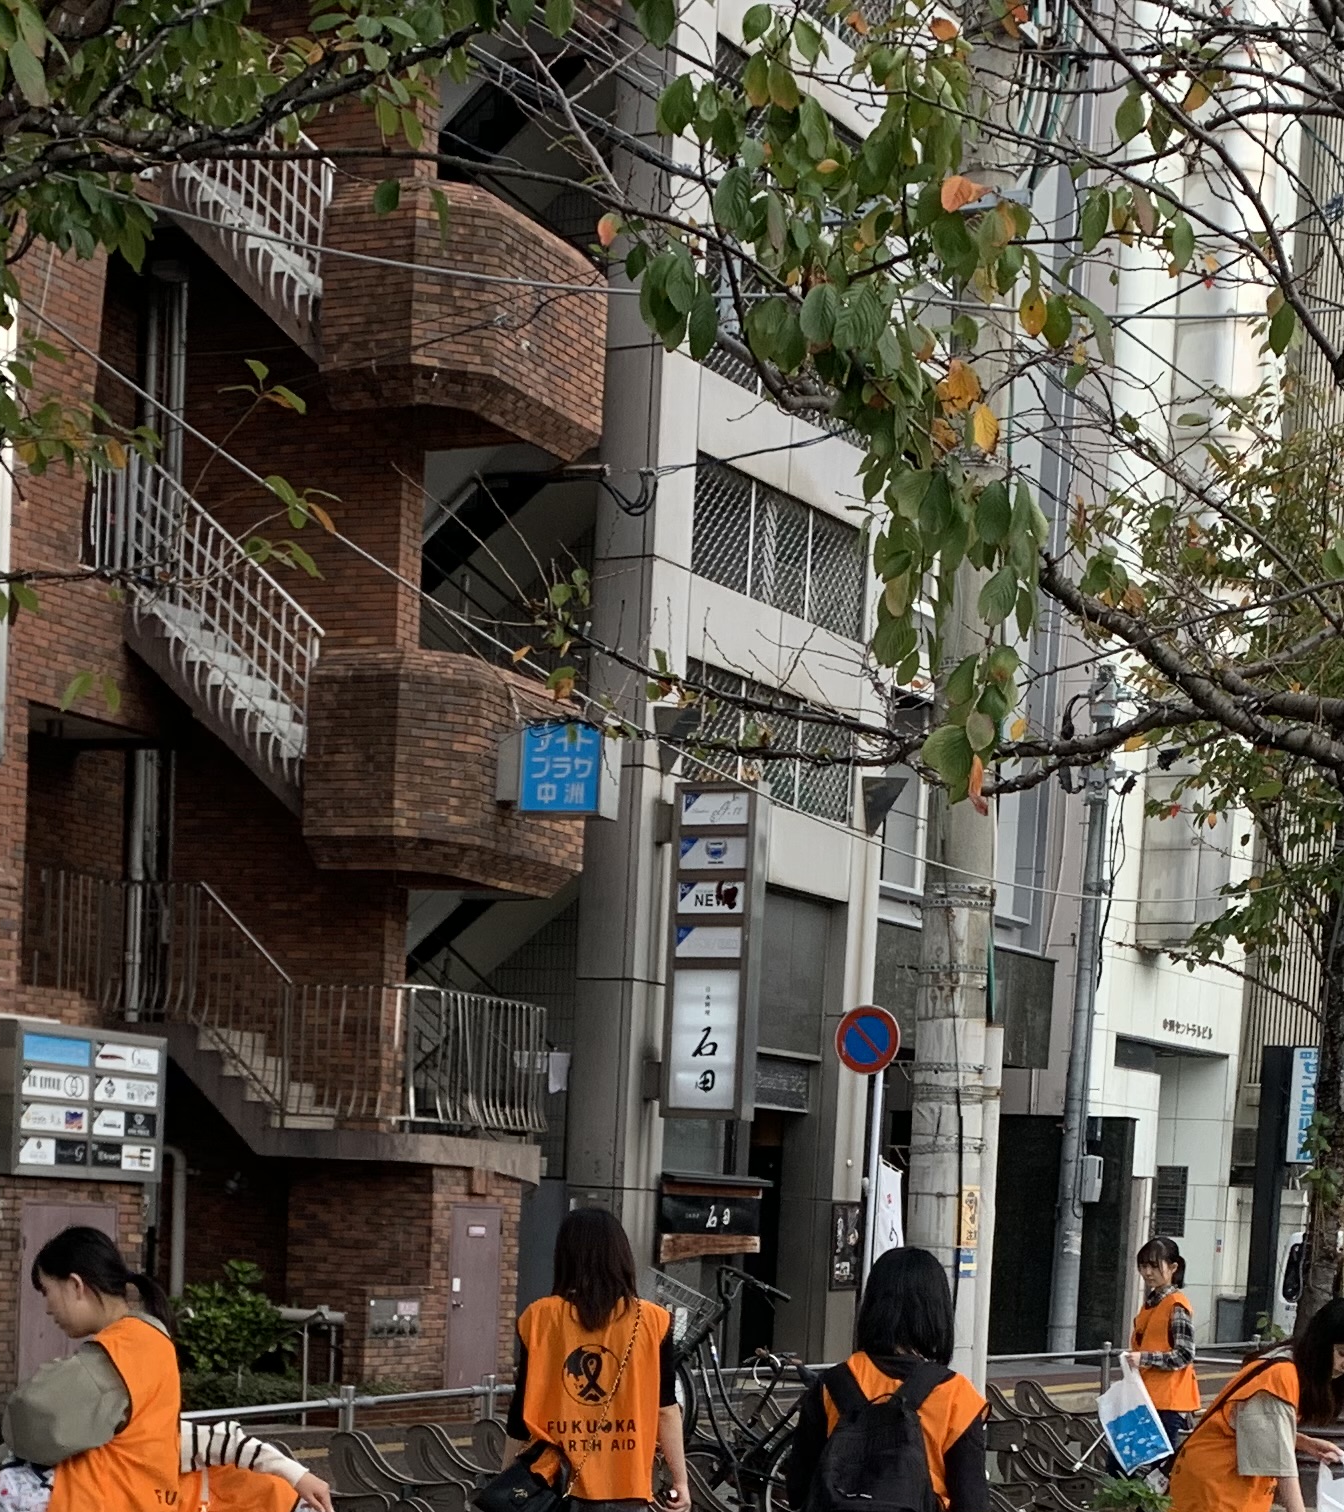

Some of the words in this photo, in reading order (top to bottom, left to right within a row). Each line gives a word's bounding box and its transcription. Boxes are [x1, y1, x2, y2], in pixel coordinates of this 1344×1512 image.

[537, 782, 584, 804] 中洲
[691, 1025, 718, 1093] 石田
[547, 1419, 636, 1435] FUKUOKA
[557, 1439, 602, 1452] ARTH
[610, 1438, 636, 1452] AID
